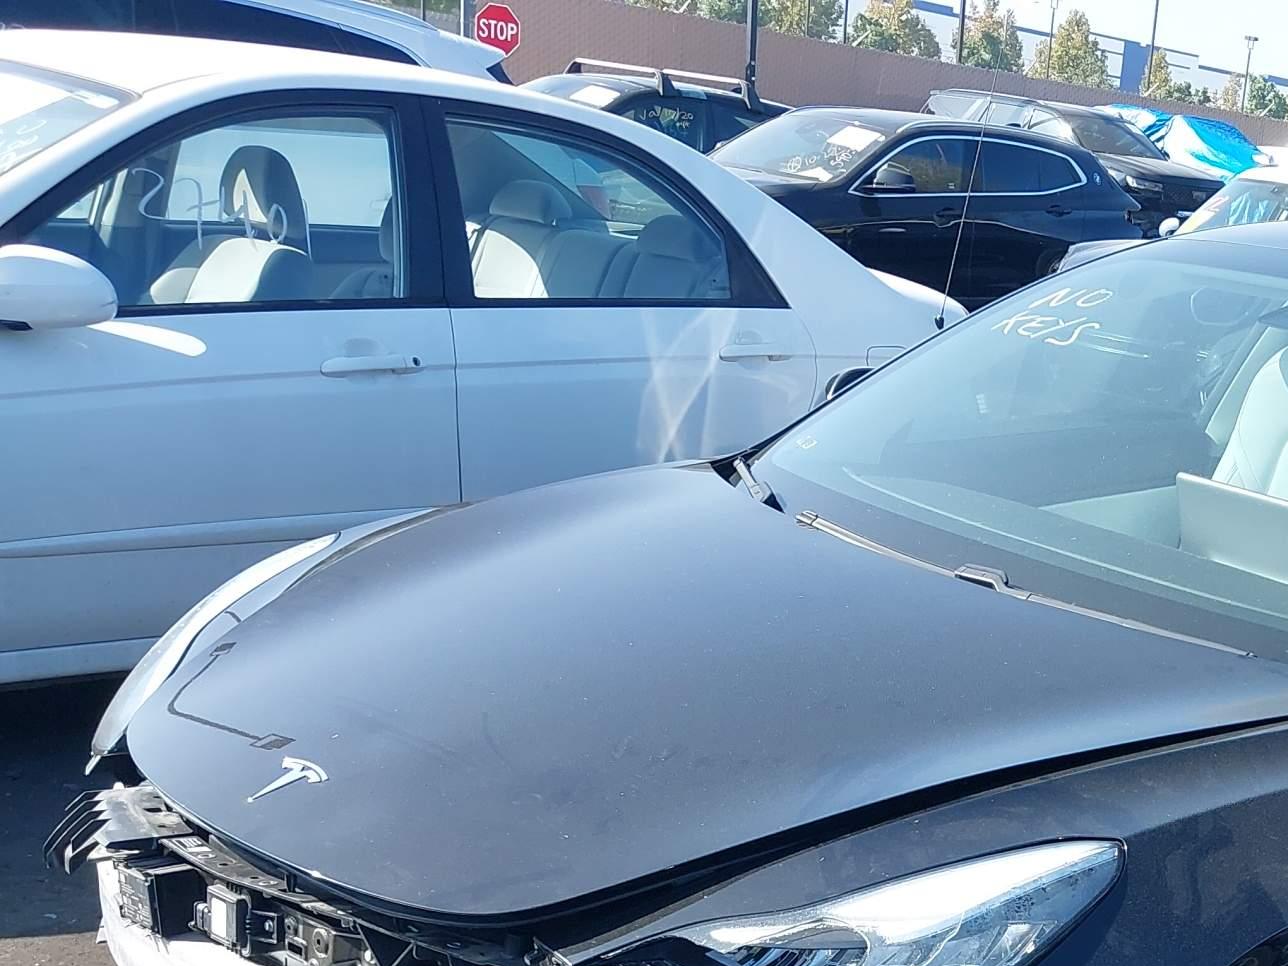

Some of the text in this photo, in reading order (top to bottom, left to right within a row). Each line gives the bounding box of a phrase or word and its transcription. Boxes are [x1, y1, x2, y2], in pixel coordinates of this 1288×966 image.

[478, 18, 517, 42] STOP
[1027, 286, 1114, 309] NO
[990, 310, 1101, 346] KEYS
